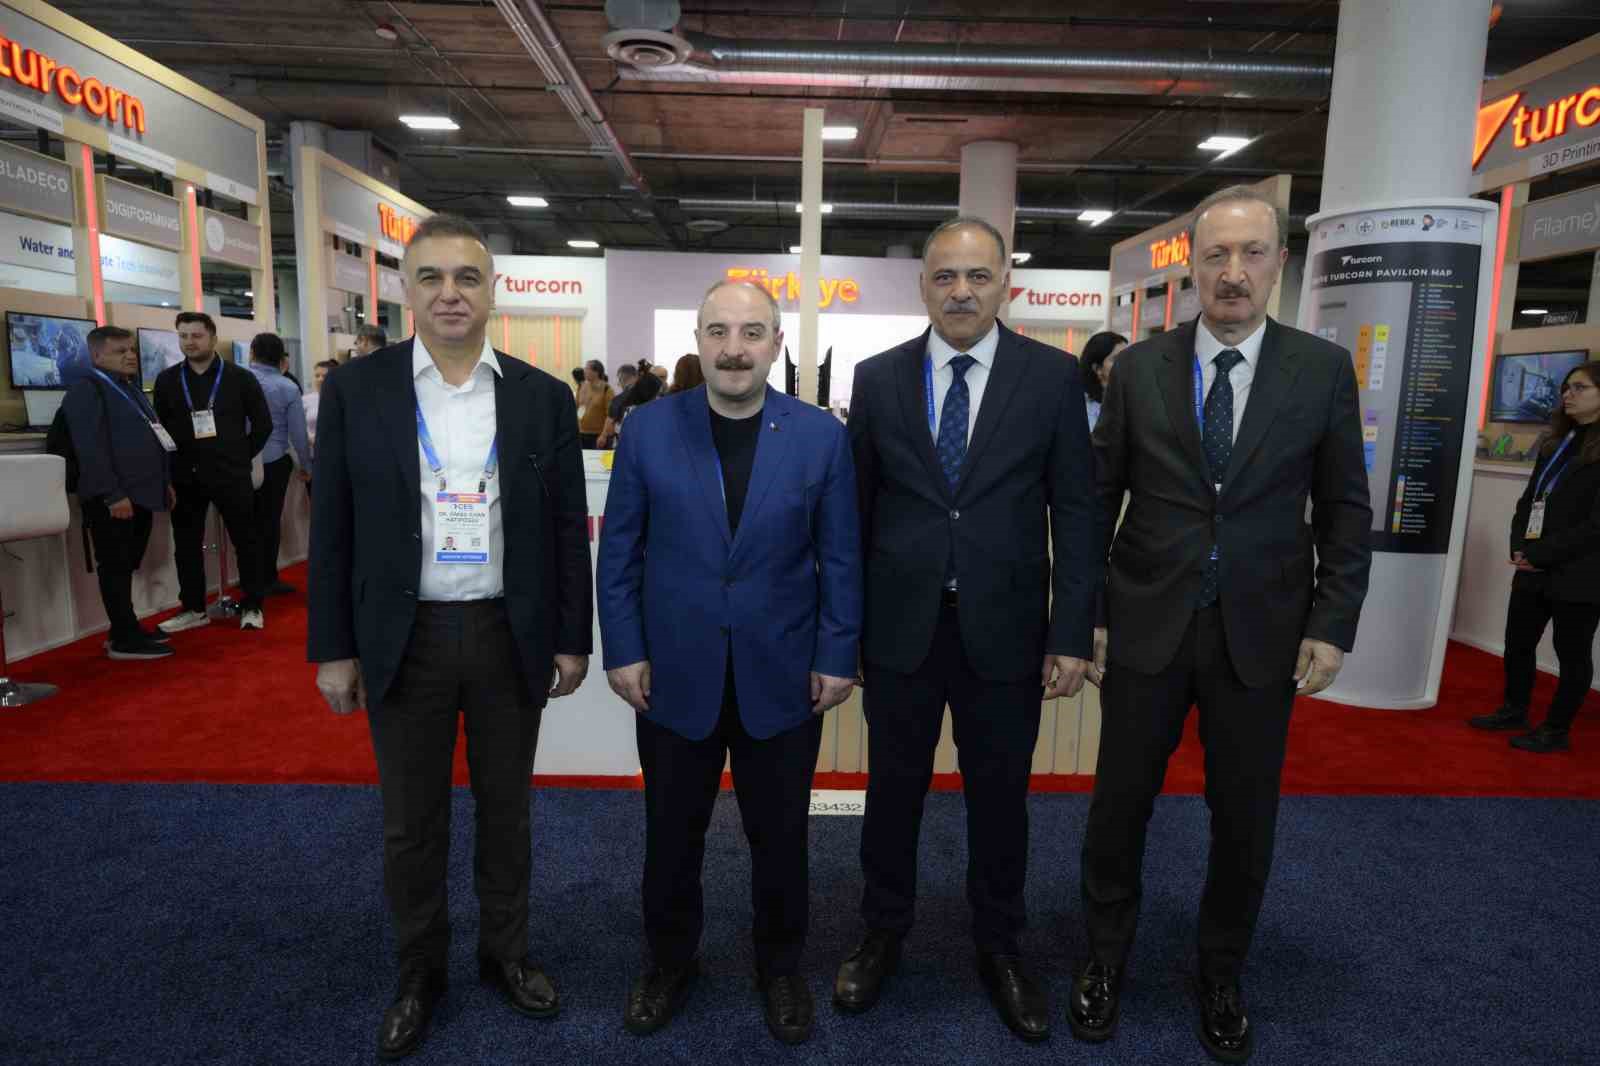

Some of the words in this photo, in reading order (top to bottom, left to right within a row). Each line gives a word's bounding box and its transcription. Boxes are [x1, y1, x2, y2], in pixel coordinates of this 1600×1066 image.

[0, 159, 68, 193] BLADECO
[19, 236, 54, 256] Water
[1376, 268, 1428, 277] PAVILION
[1431, 268, 1453, 277] MAP
[505, 276, 582, 294] turcorn
[1027, 288, 1102, 306] turcorn
